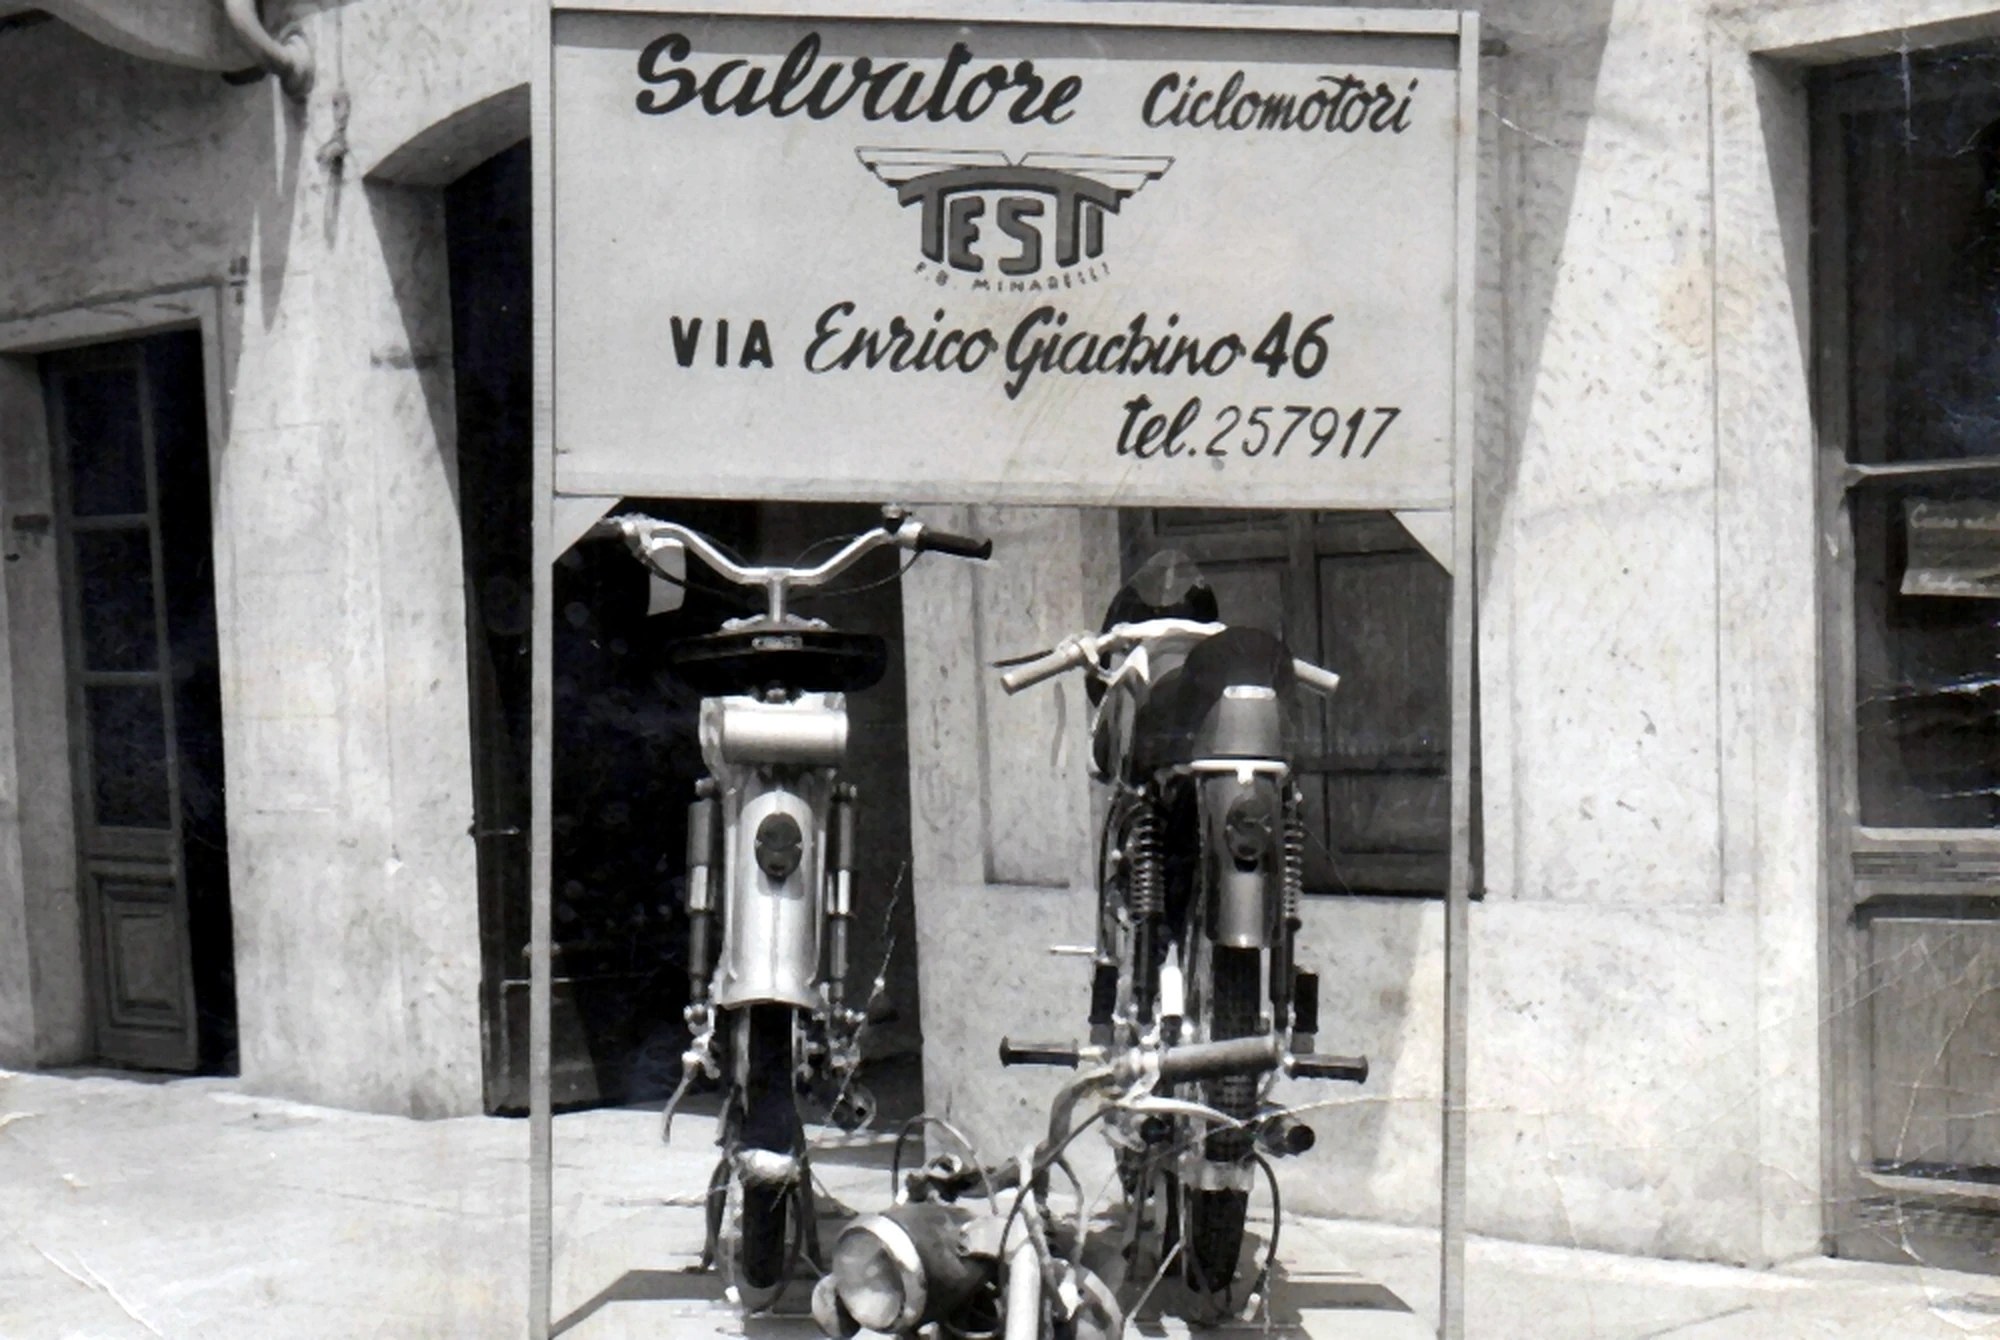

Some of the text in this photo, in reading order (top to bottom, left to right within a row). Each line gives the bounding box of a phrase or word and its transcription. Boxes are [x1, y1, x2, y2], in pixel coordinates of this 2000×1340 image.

[635, 31, 1085, 125] Salvatore
[1142, 70, 1419, 134] Ciclomotori
[895, 164, 1122, 276] TESTI
[670, 301, 1334, 401] VIA Enrico Giachino 46
[1116, 393, 1402, 459] tel. 257917
